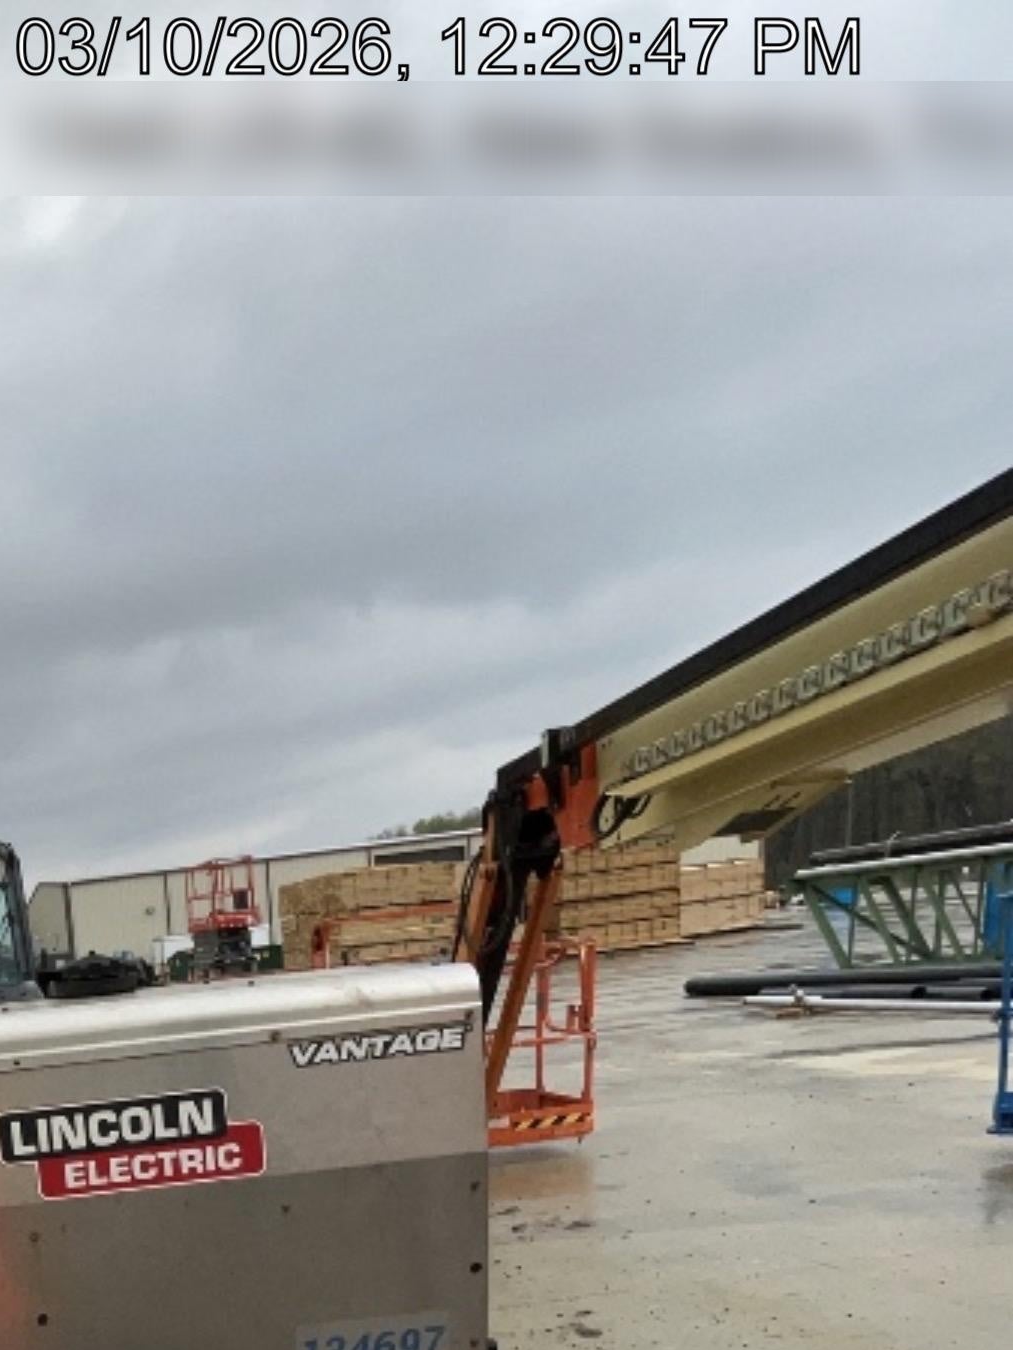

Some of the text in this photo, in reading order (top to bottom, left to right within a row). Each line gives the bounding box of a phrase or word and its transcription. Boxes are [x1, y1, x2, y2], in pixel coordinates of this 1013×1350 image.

[290, 1026, 466, 1067] VANTAGE
[9, 1098, 216, 1157] LINCOLN
[63, 1143, 245, 1190] ELECTRIC
